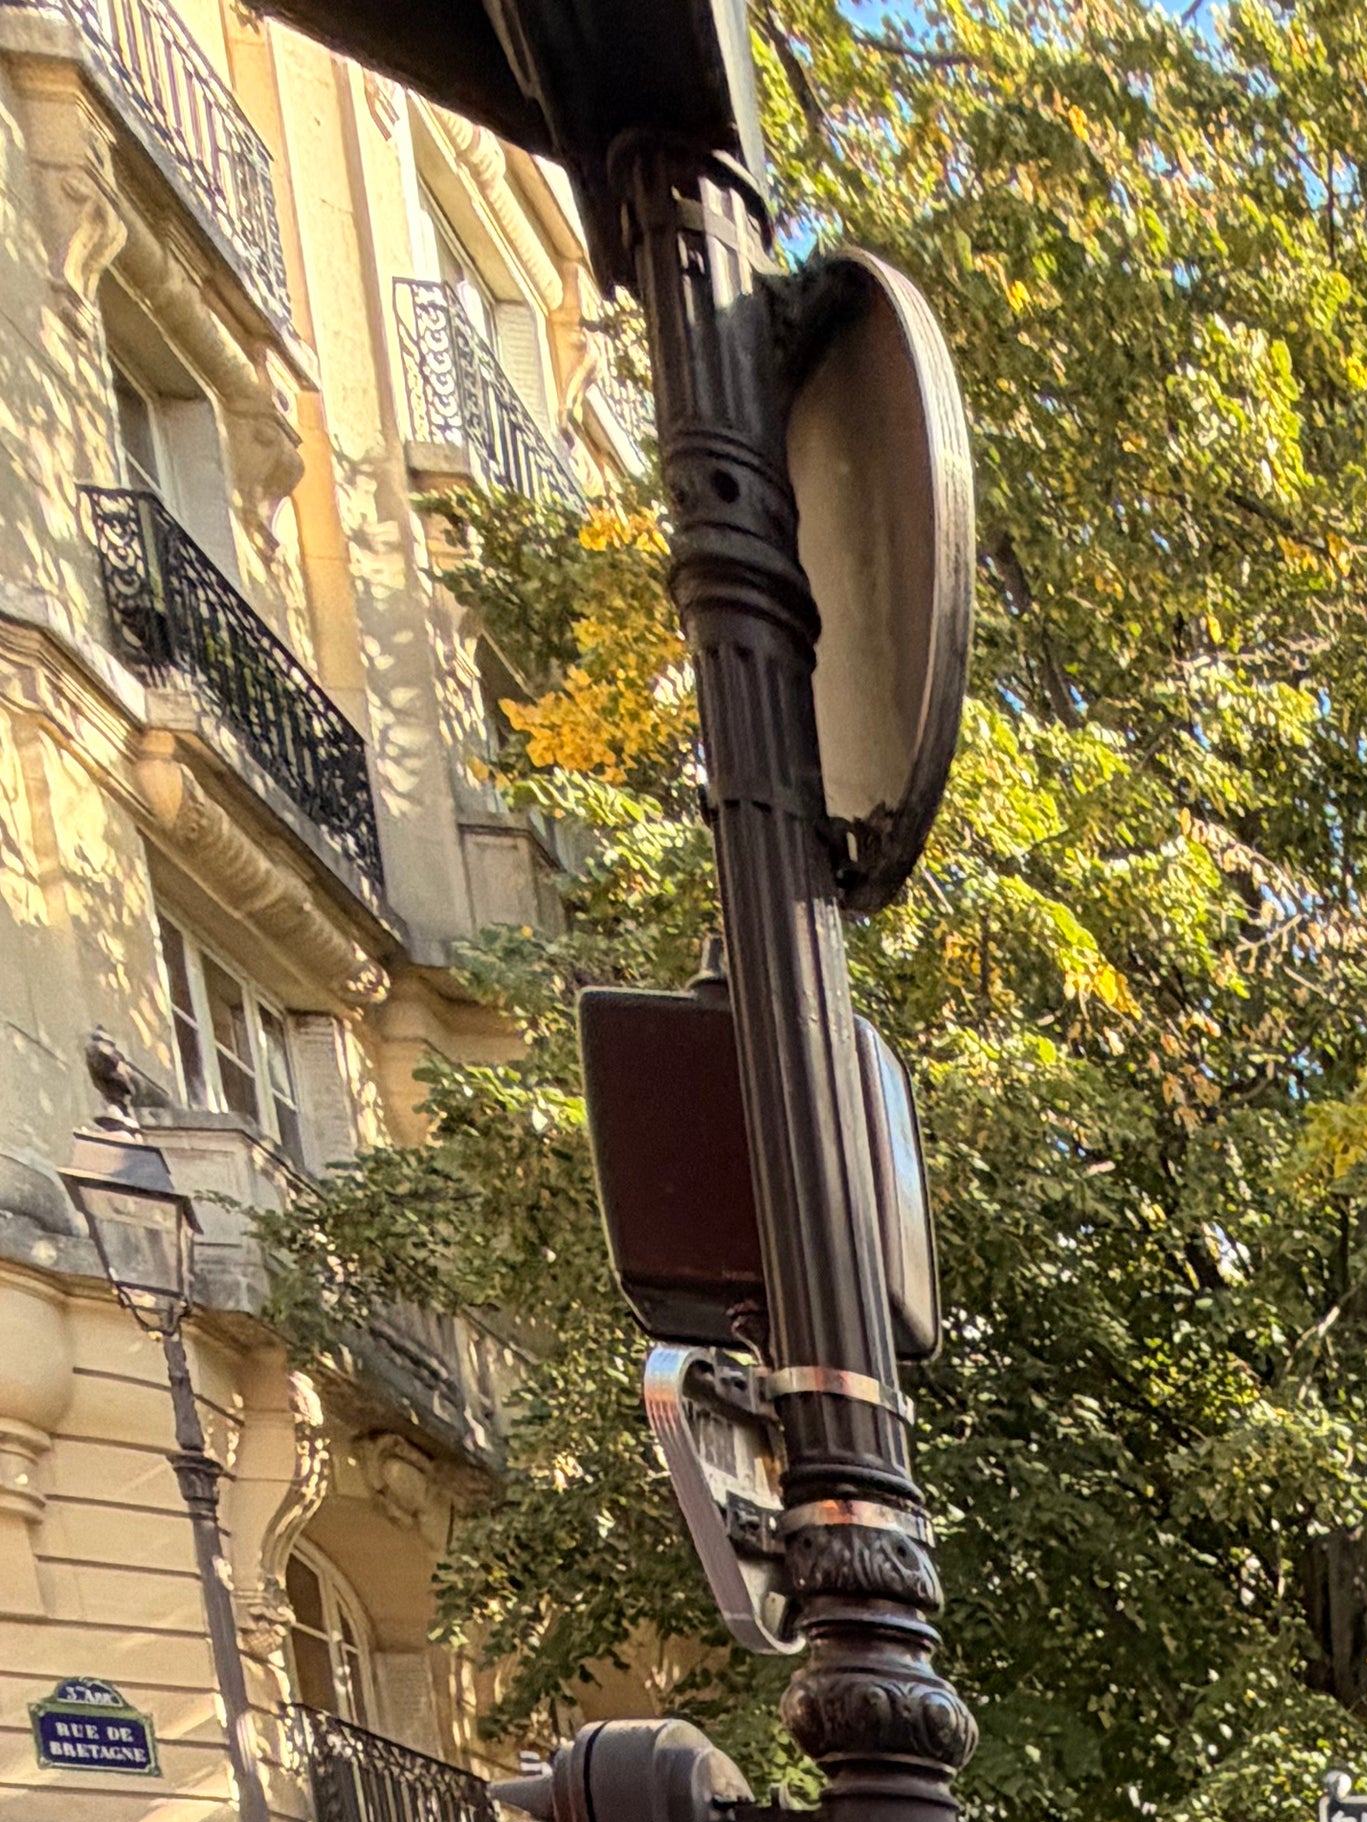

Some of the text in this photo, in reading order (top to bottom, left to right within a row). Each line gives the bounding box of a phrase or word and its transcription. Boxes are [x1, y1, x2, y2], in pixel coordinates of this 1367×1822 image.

[55, 1721, 134, 1742] RUE DE
[49, 1741, 147, 1763] BRETAGNE
